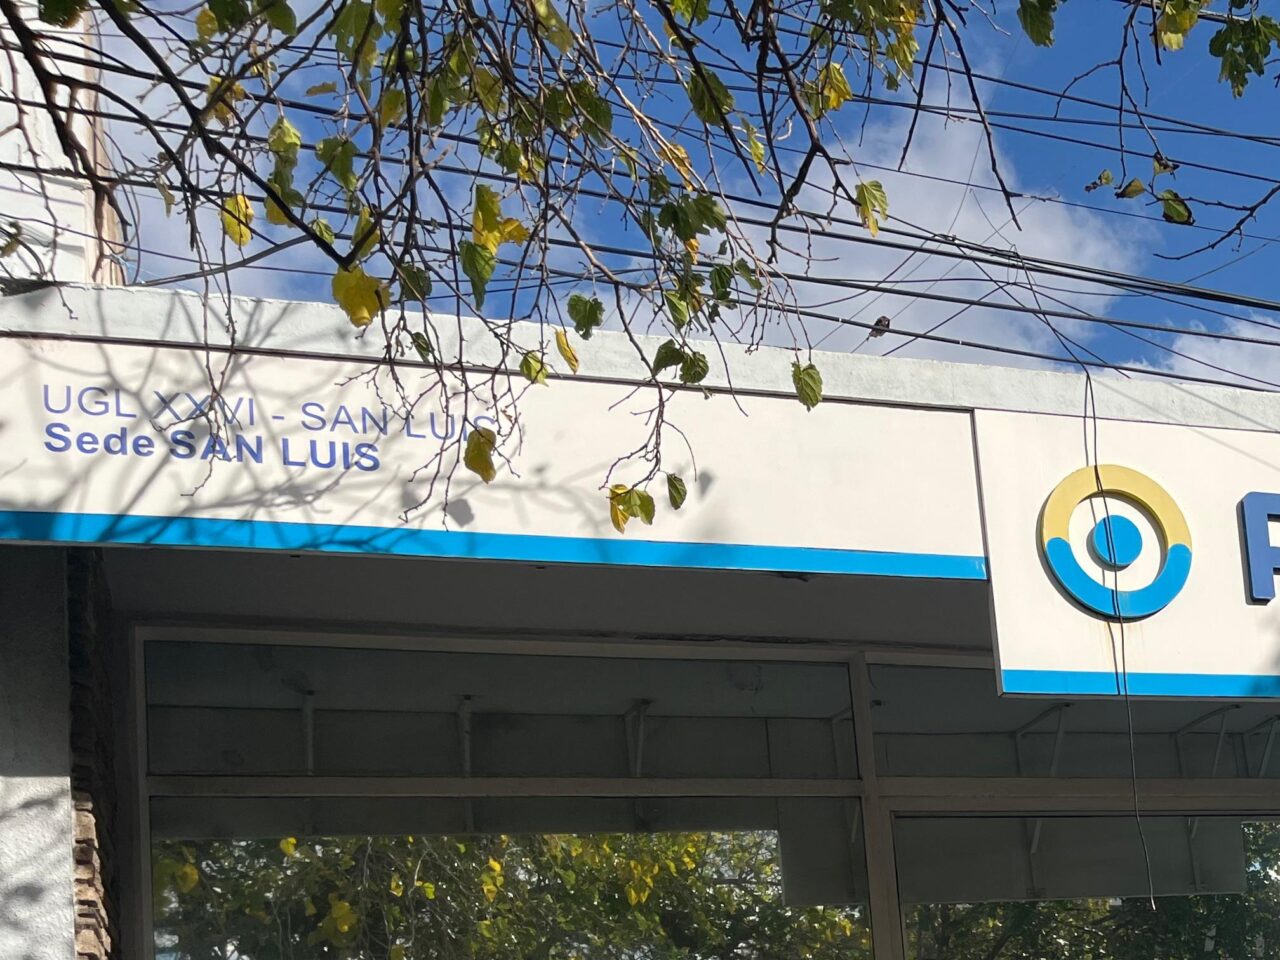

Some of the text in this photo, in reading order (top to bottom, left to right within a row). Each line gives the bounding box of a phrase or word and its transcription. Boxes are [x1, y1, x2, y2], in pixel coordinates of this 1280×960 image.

[43, 385, 136, 418] UGL
[154, 391, 254, 426] XXVI
[301, 402, 387, 436] SAN
[44, 422, 380, 471] Sede SAN LUIS
